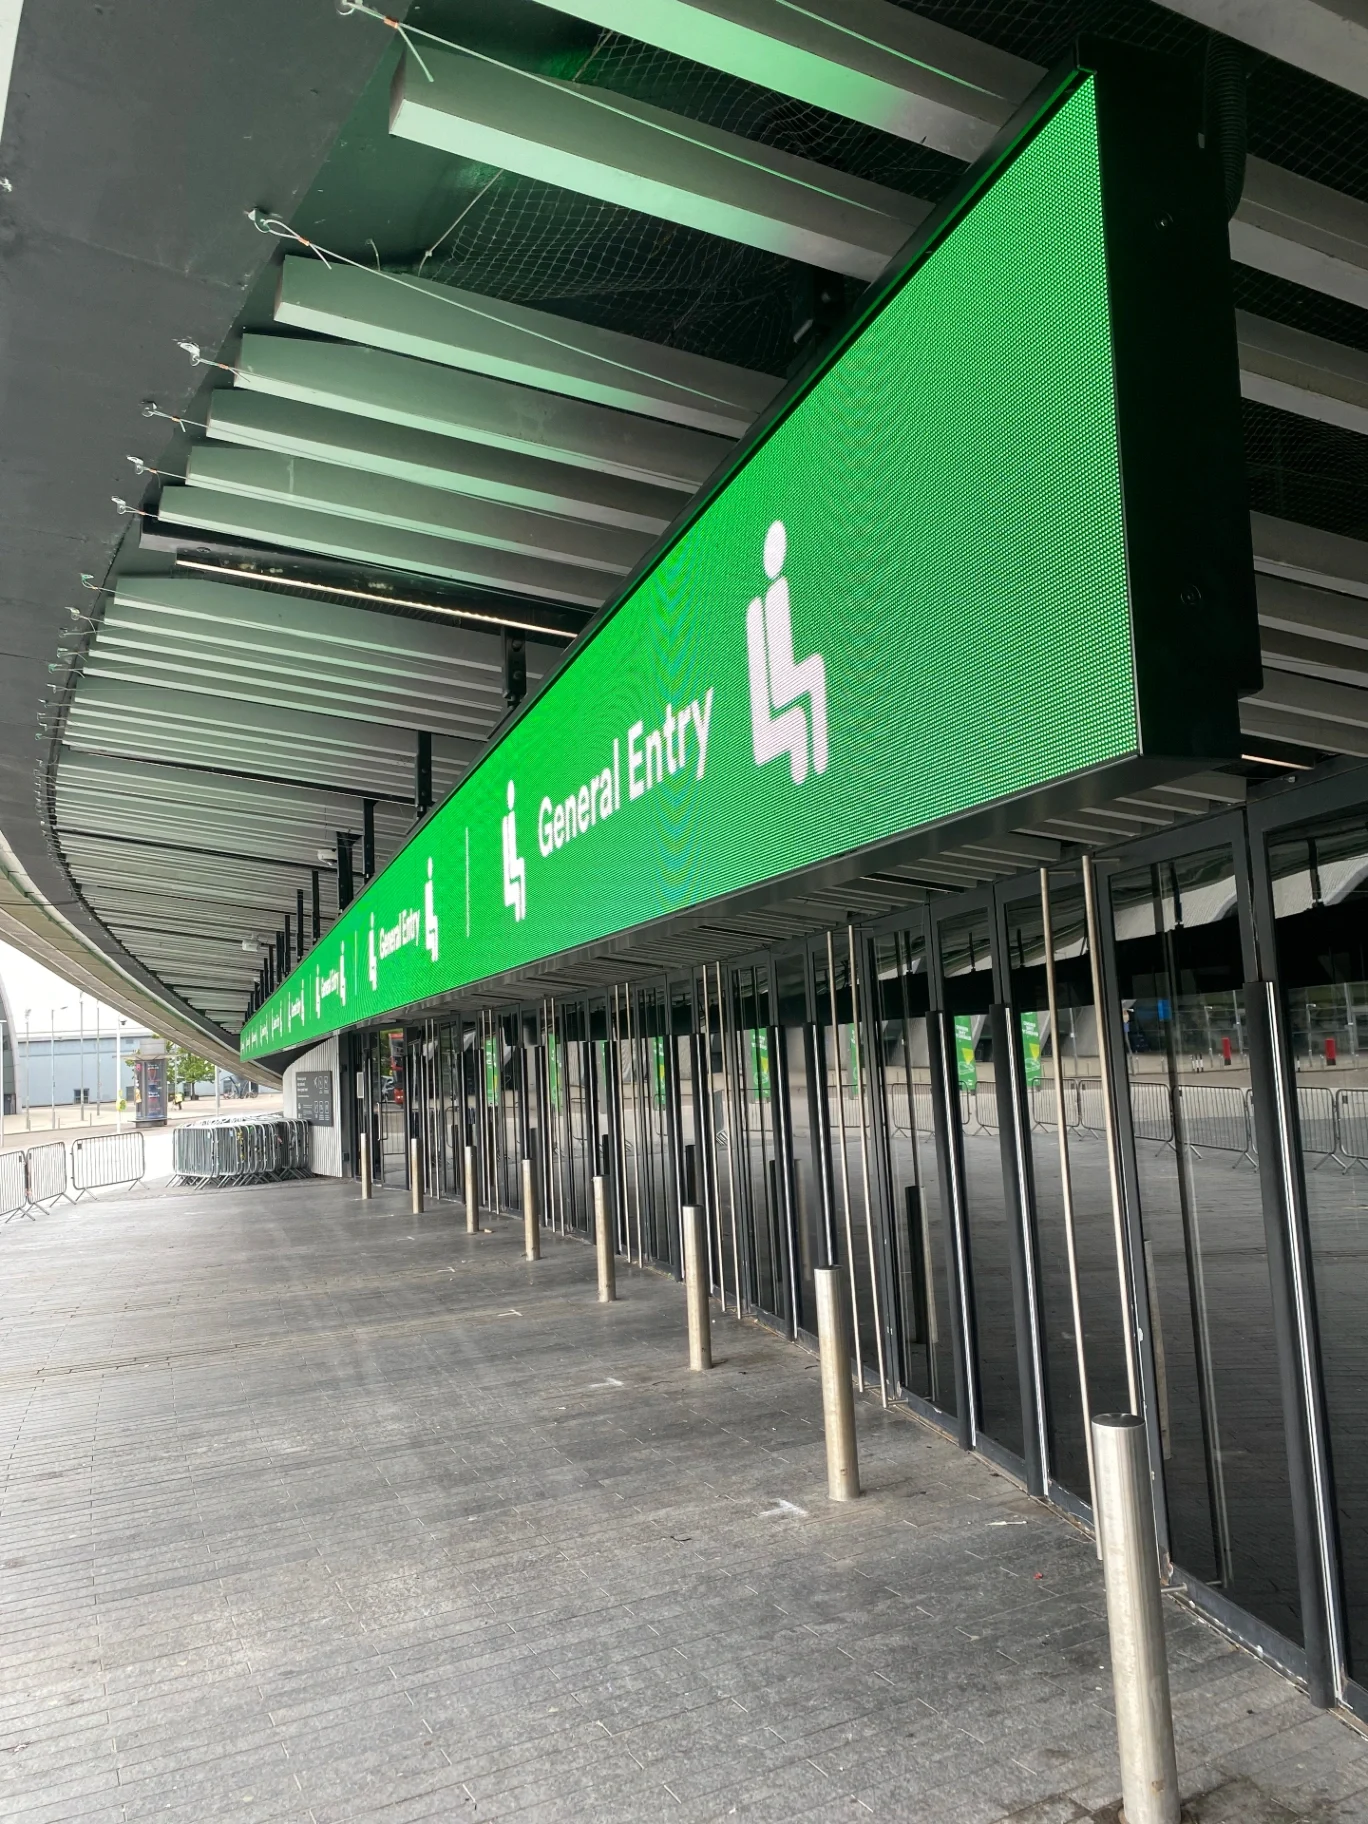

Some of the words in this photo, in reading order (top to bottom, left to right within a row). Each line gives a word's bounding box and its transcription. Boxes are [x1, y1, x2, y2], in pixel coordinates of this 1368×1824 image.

[538, 738, 620, 857] General
[627, 686, 714, 801] Entry
[380, 912, 401, 960] General
[402, 907, 421, 947] Entry
